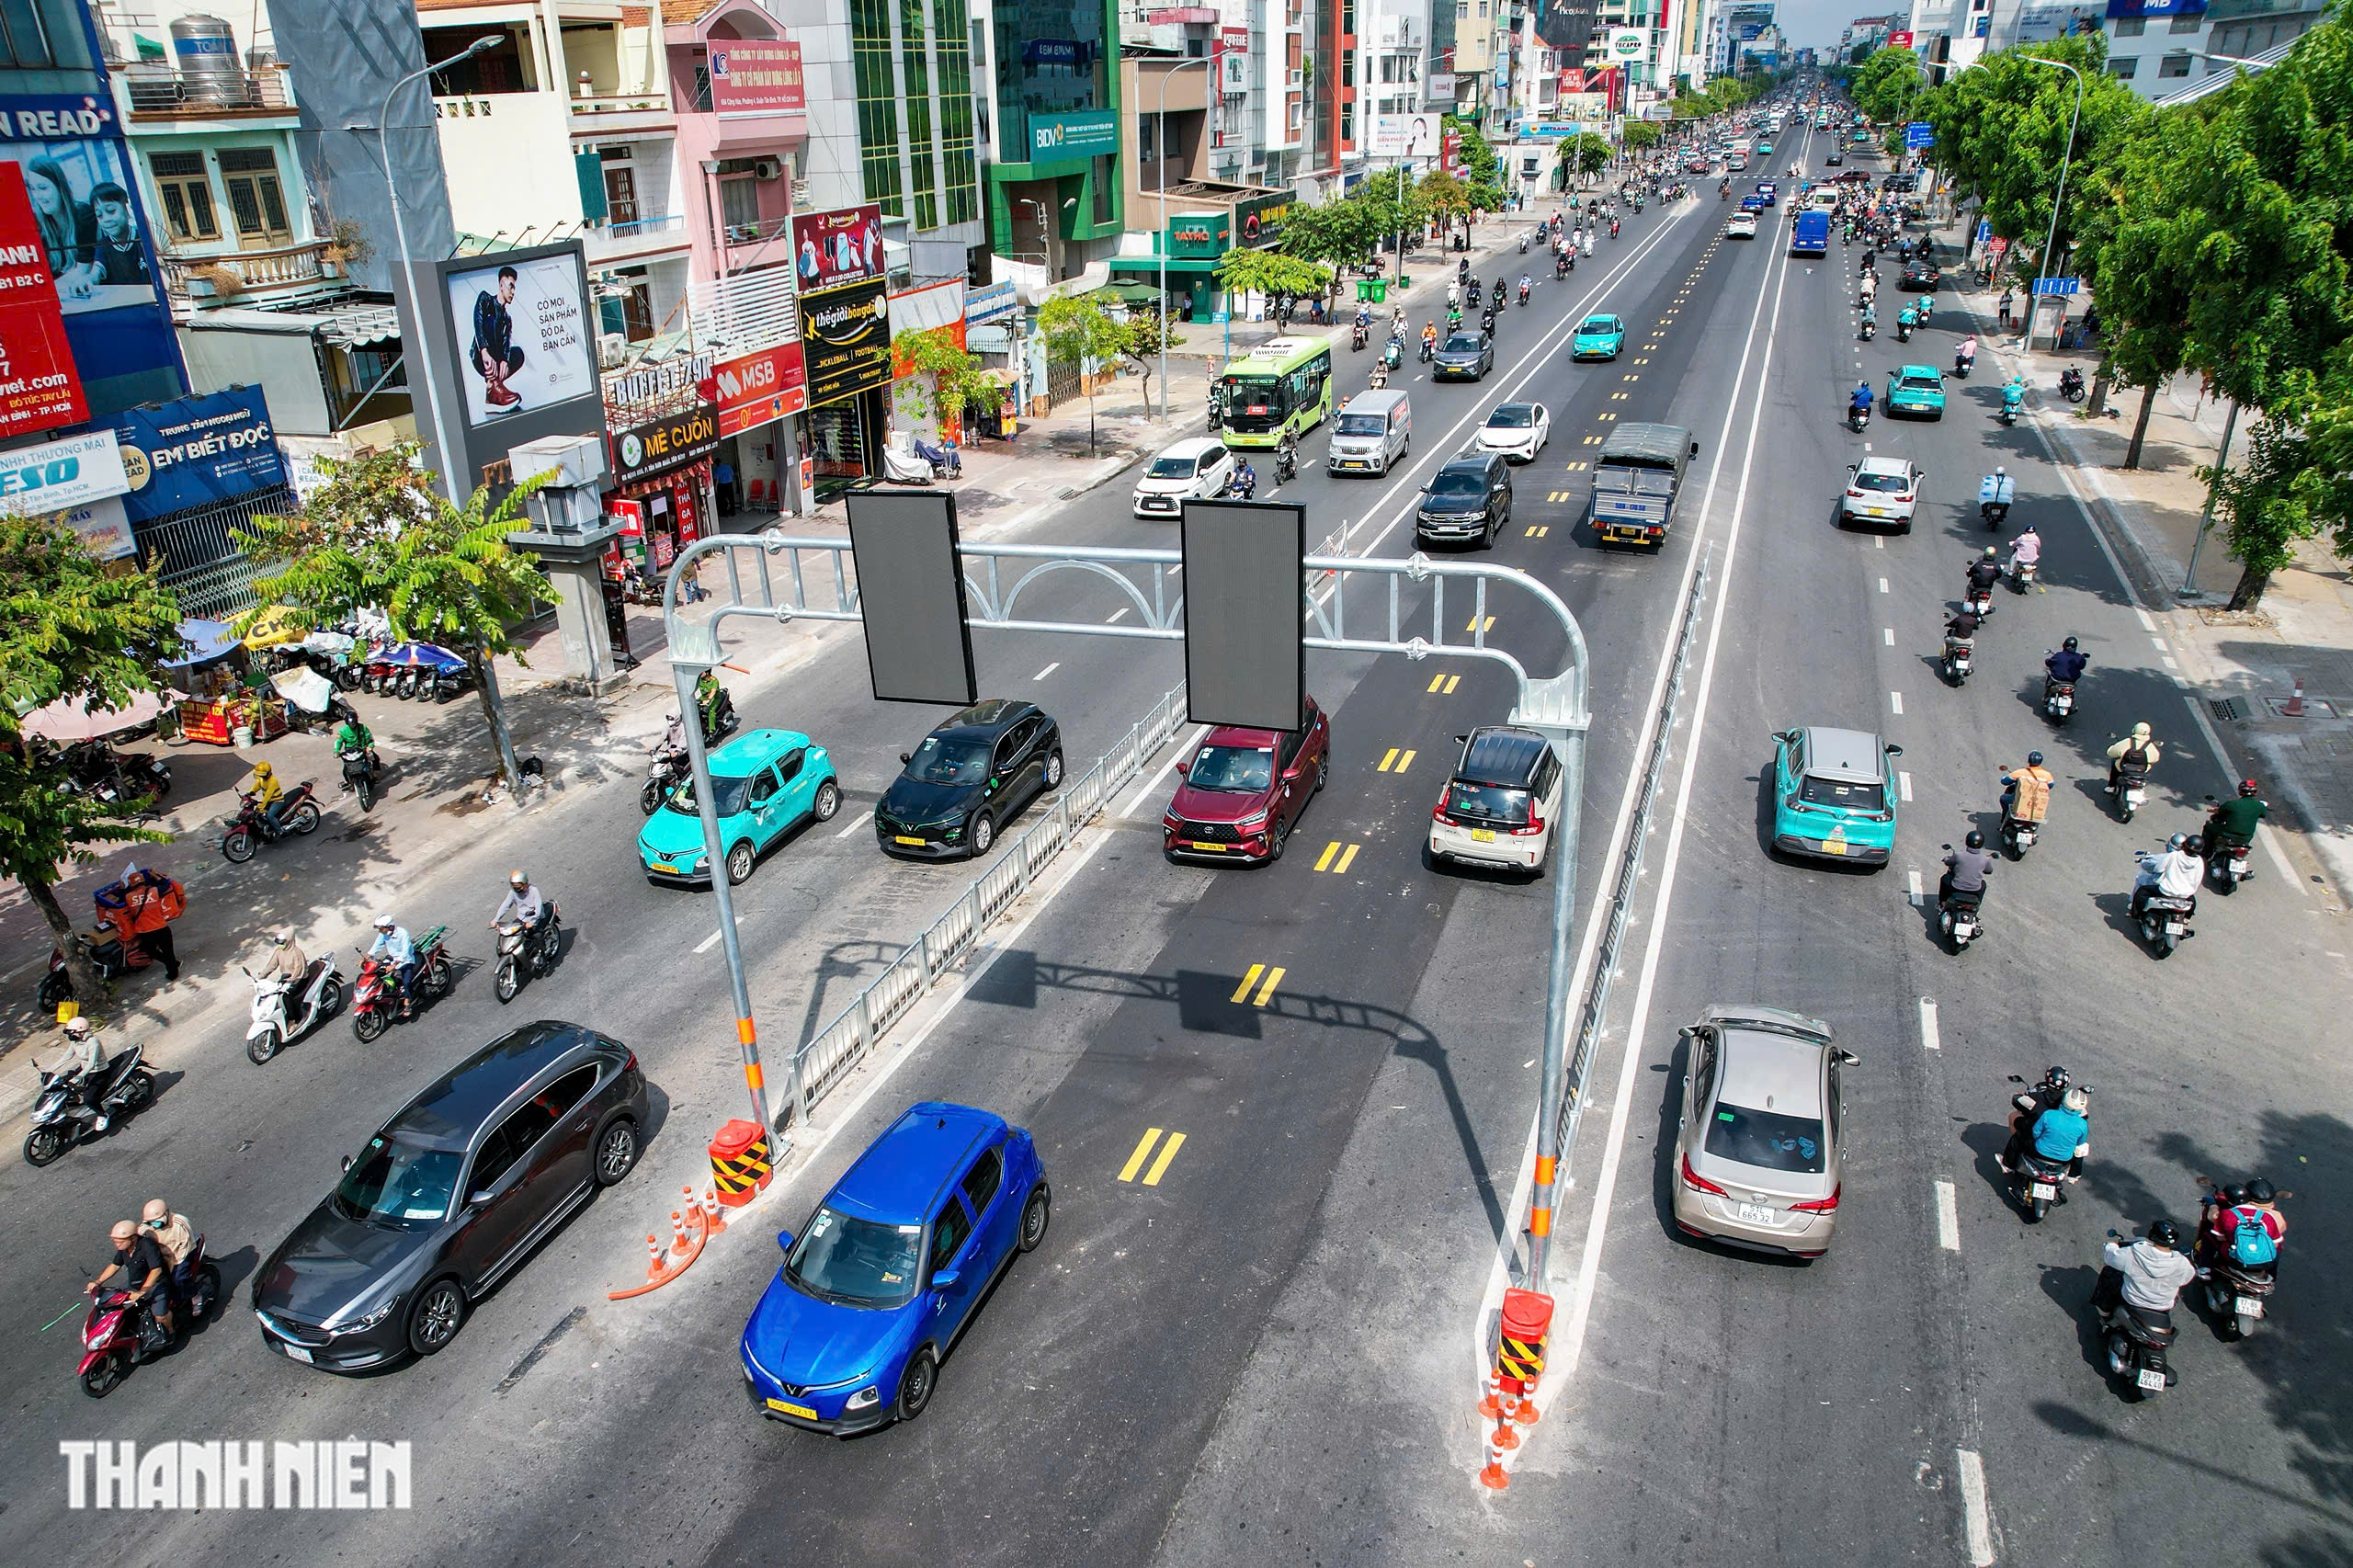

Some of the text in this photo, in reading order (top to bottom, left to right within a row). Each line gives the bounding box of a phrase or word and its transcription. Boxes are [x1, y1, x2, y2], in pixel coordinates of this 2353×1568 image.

[16, 109, 101, 137] READ
[1036, 128, 1057, 148] BIDV
[16, 275, 33, 287] B2
[553, 324, 564, 335] DA
[855, 345, 879, 358] FOOTBALL
[615, 356, 713, 406] BUFFET 79K
[742, 360, 775, 392] MSB
[52, 402, 72, 413] HCM
[159, 425, 190, 437] TRUNG
[644, 427, 669, 458] MÊ
[29, 443, 82, 463] THƯƠNG
[85, 437, 106, 451] MẠI
[152, 445, 184, 468] EM
[186, 431, 226, 460] BIẾT
[681, 508, 691, 519] GA
[1749, 1204, 1765, 1215] 51L
[1742, 1210, 1770, 1223] 665.32
